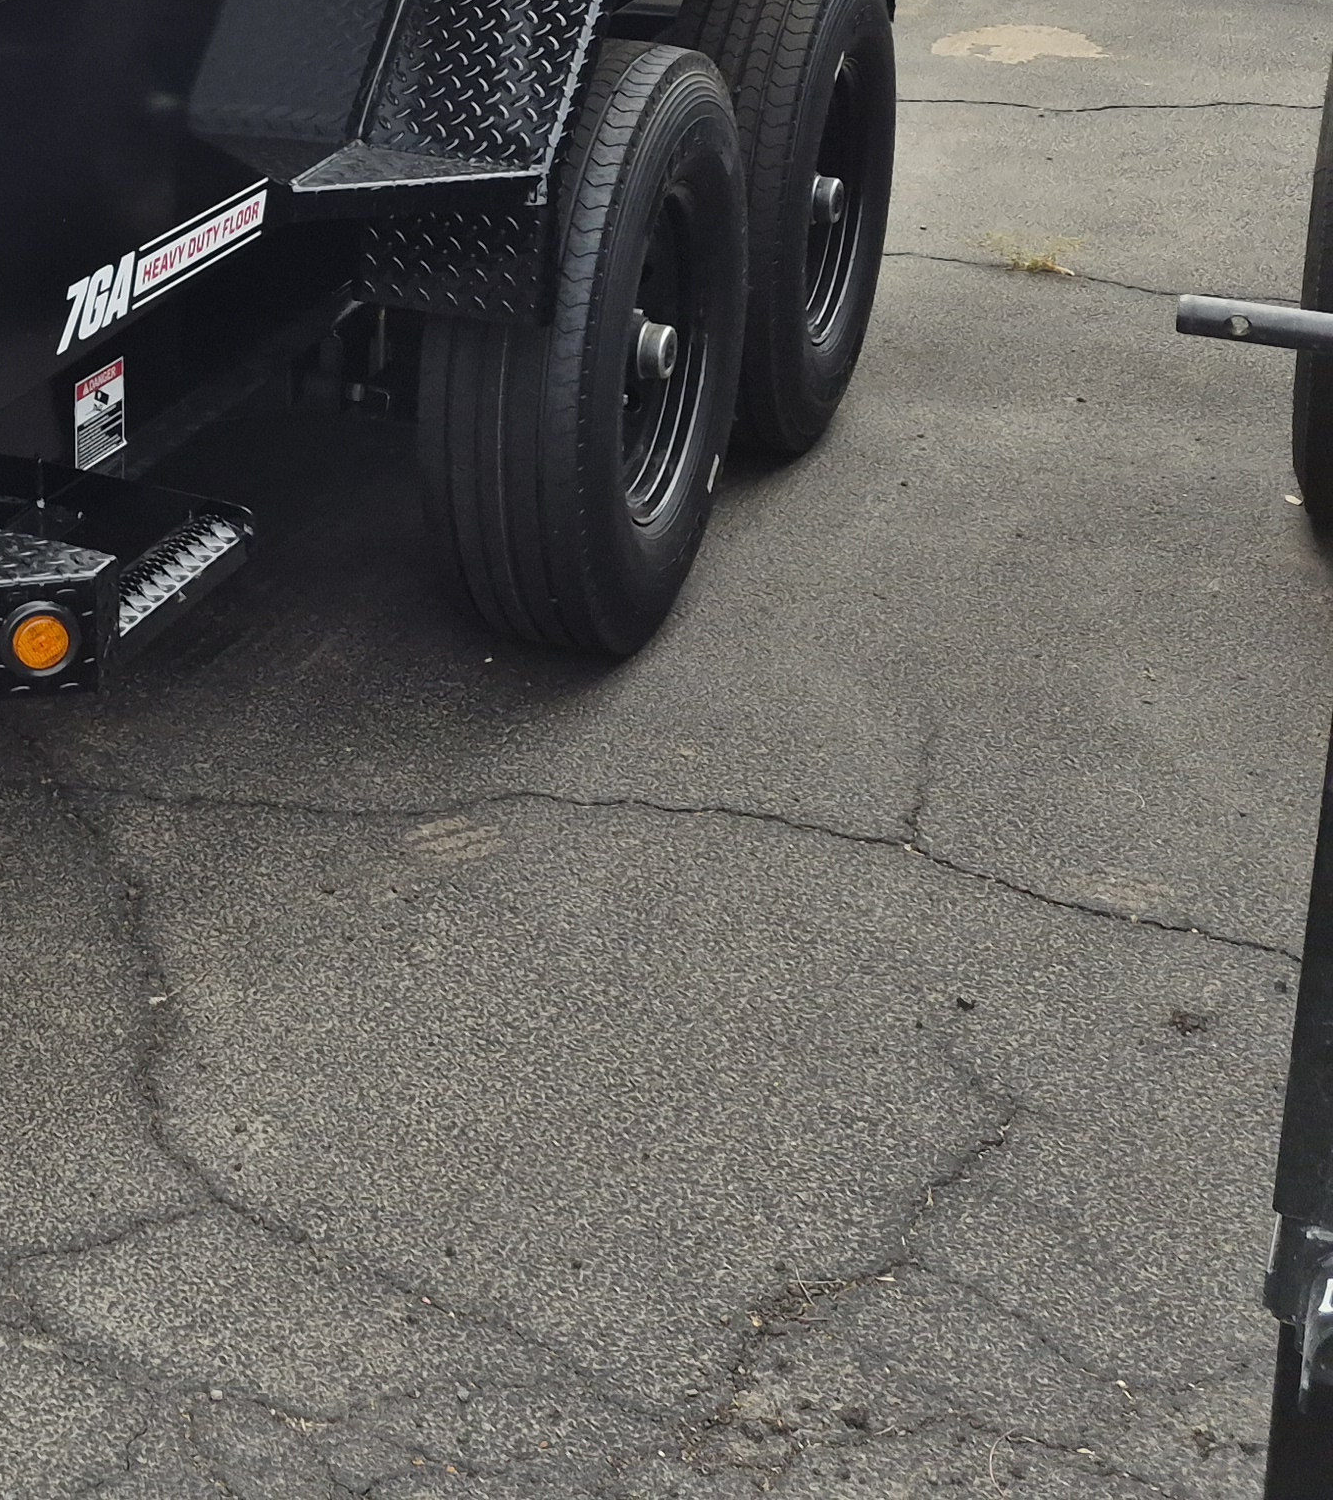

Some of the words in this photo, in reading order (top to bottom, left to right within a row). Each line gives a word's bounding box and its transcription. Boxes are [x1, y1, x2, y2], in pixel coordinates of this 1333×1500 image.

[56, 251, 135, 355] 7GA
[142, 242, 186, 285] HEAVY
[187, 223, 221, 258] DUTY
[222, 201, 260, 239] FLOOR
[89, 366, 117, 390] DANGER
